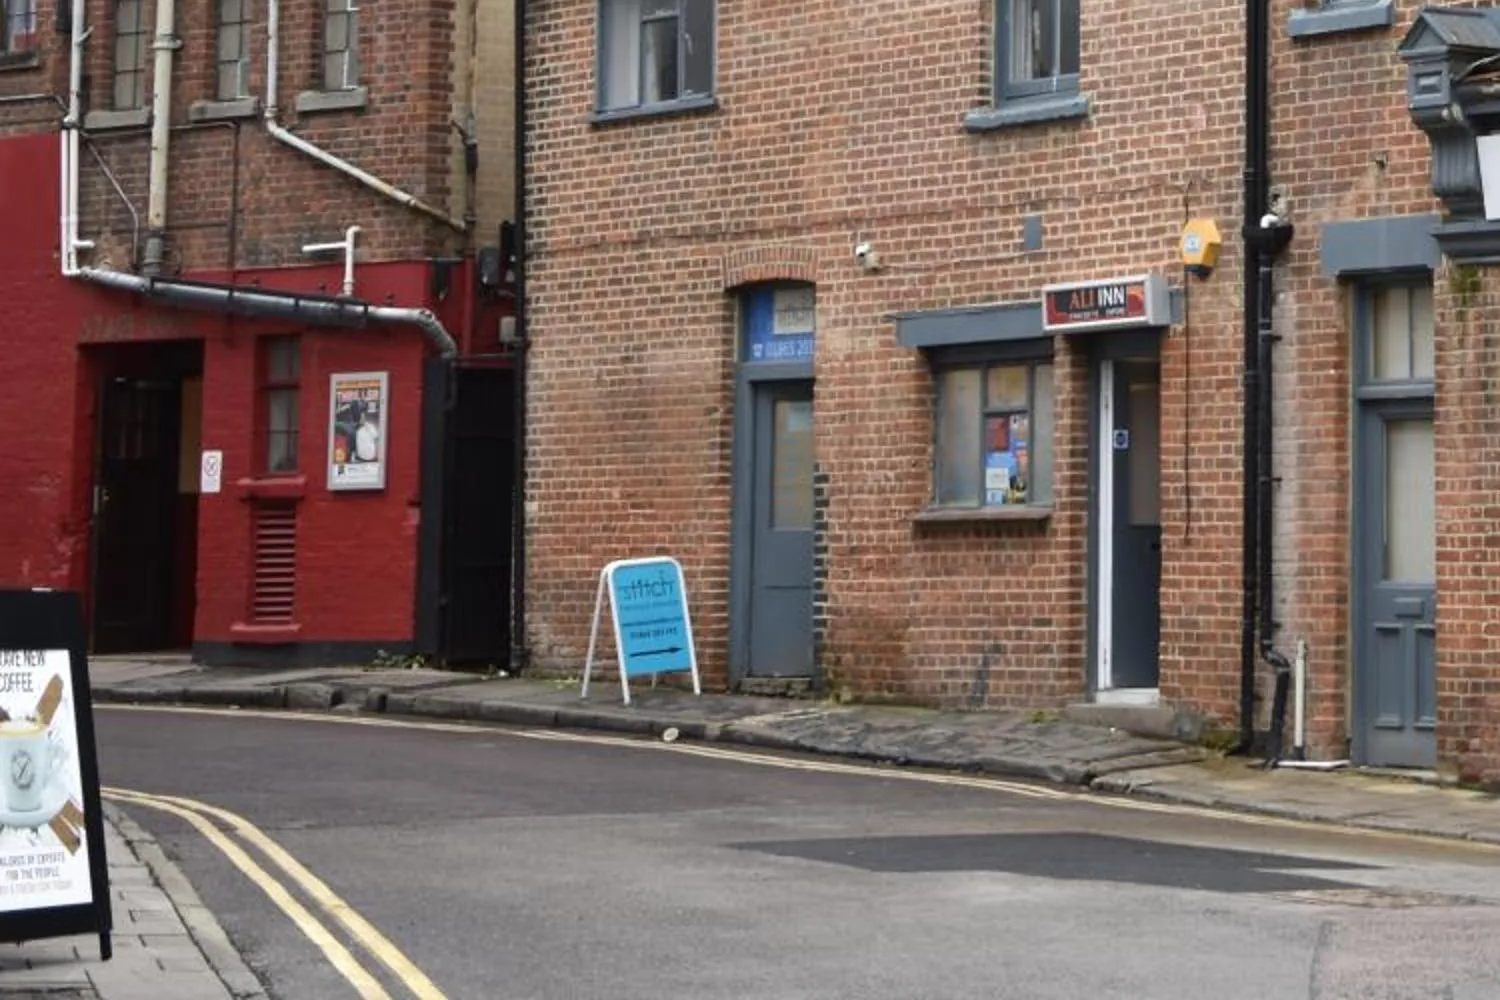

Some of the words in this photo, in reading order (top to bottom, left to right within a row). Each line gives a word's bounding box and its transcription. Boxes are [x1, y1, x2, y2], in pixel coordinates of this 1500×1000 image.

[1070, 289, 1095, 311] ALI
[1098, 285, 1124, 307] INN
[23, 649, 46, 667] NEW
